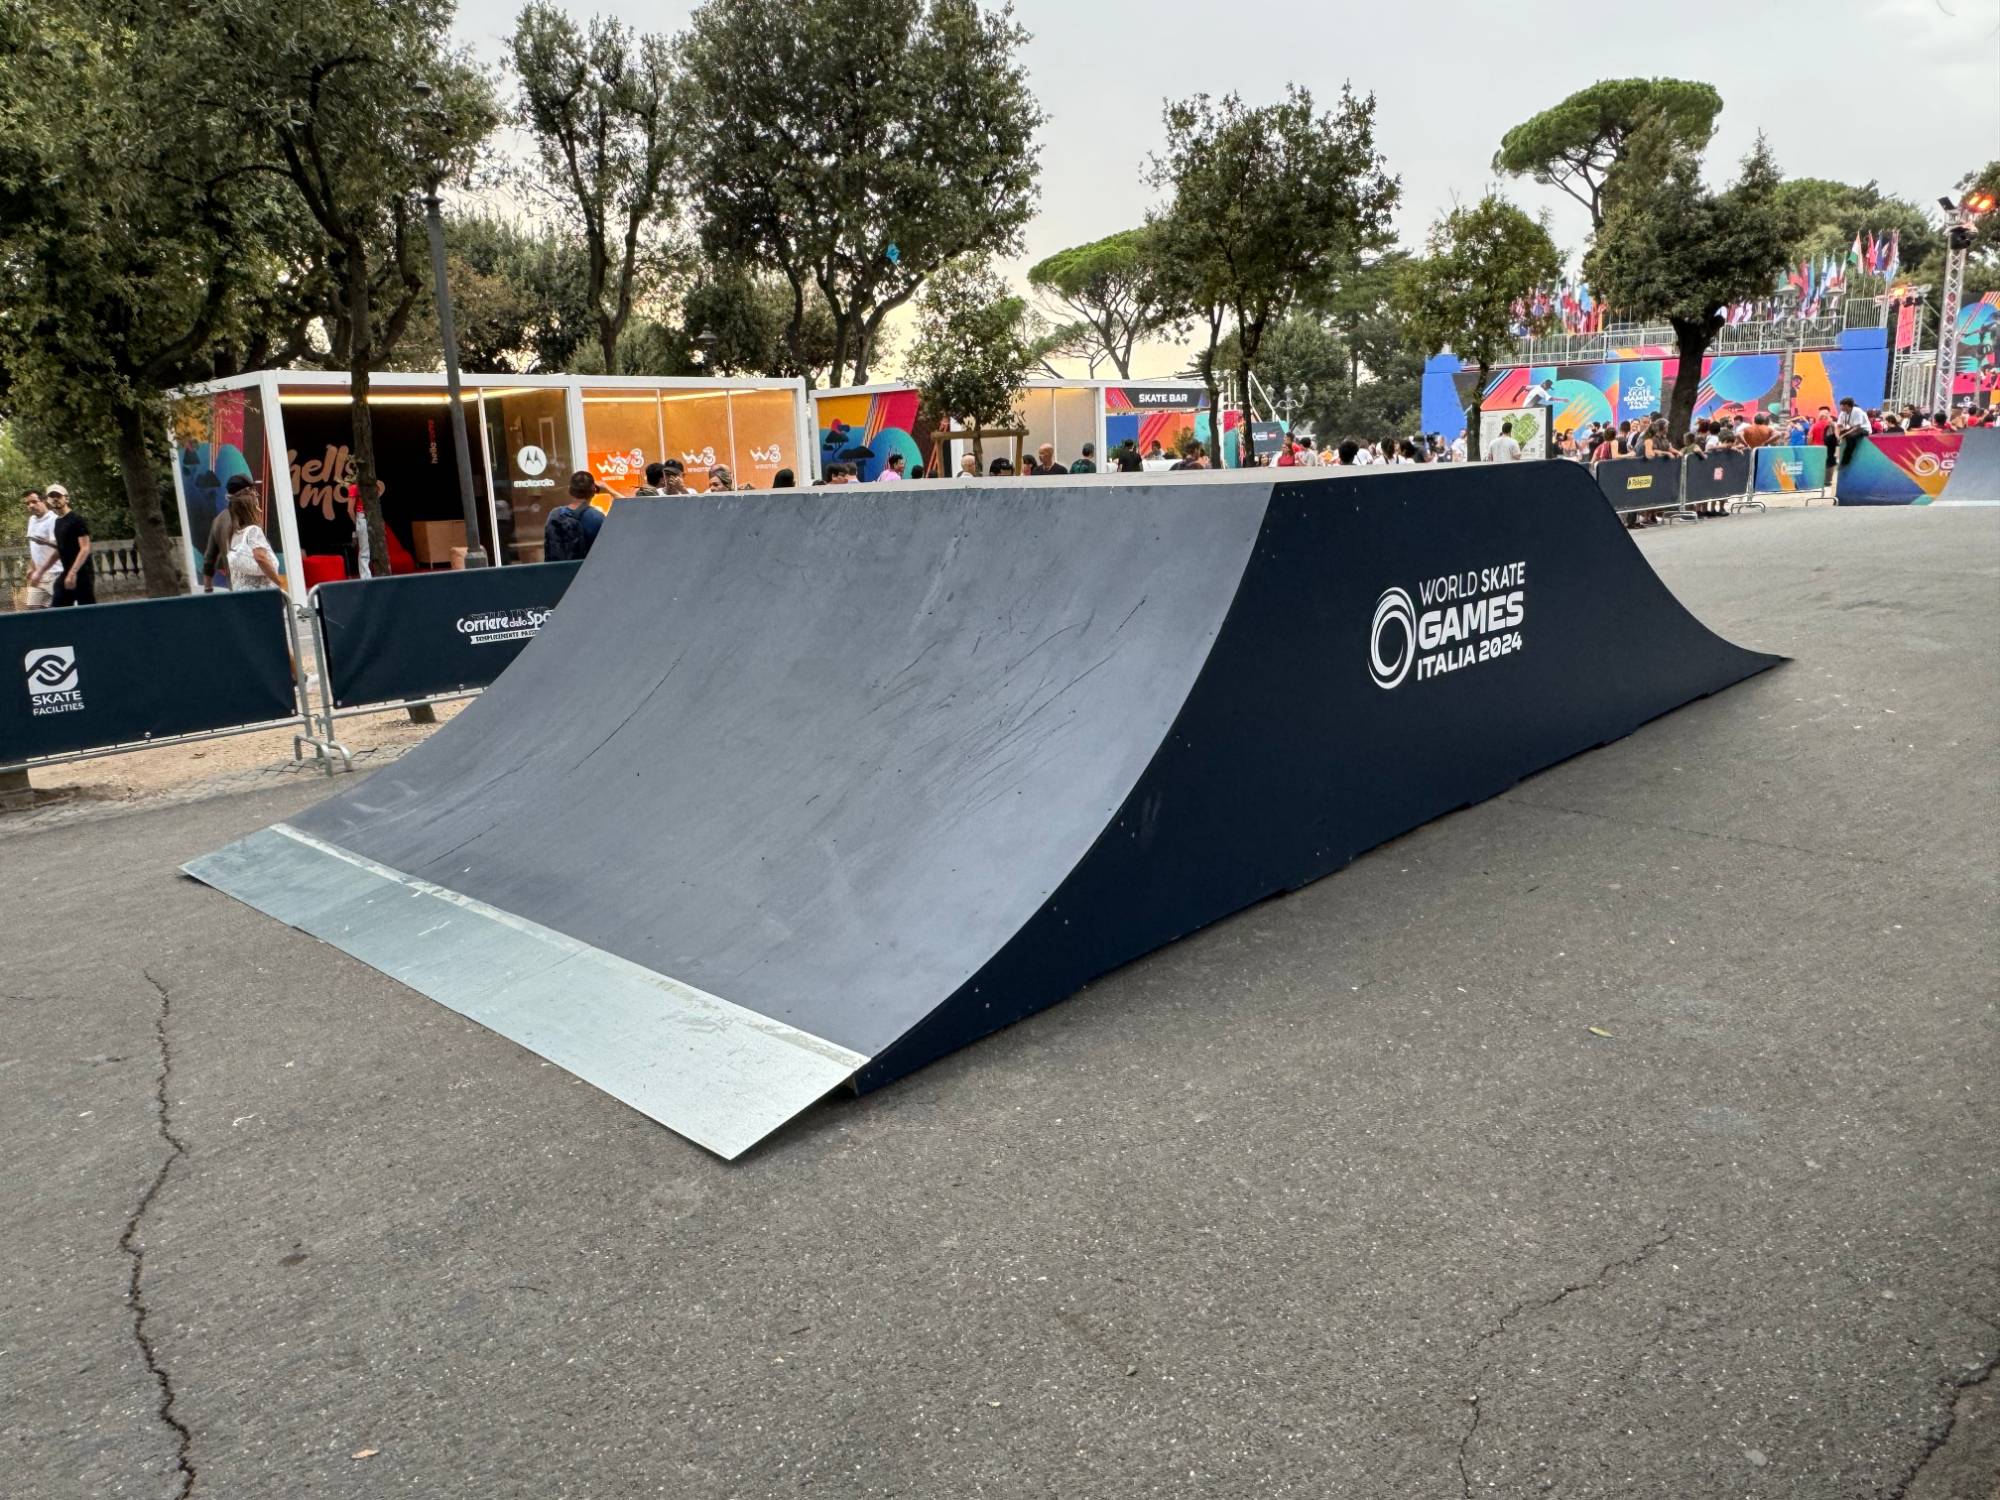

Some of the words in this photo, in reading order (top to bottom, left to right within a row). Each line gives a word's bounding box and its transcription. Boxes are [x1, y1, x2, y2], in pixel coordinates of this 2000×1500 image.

[1138, 393, 1167, 402] SKATE
[1169, 393, 1188, 402] BAR
[513, 479, 555, 488] motorola
[1419, 571, 1478, 606] WORLD
[1481, 561, 1526, 593] SKATE
[456, 616, 509, 633] Corriere
[1418, 591, 1524, 650] GAMES
[1417, 645, 1476, 681] ITALIA
[1478, 631, 1523, 662] 2024
[32, 690, 82, 706] SKATE
[33, 702, 85, 716] FACILITIES
